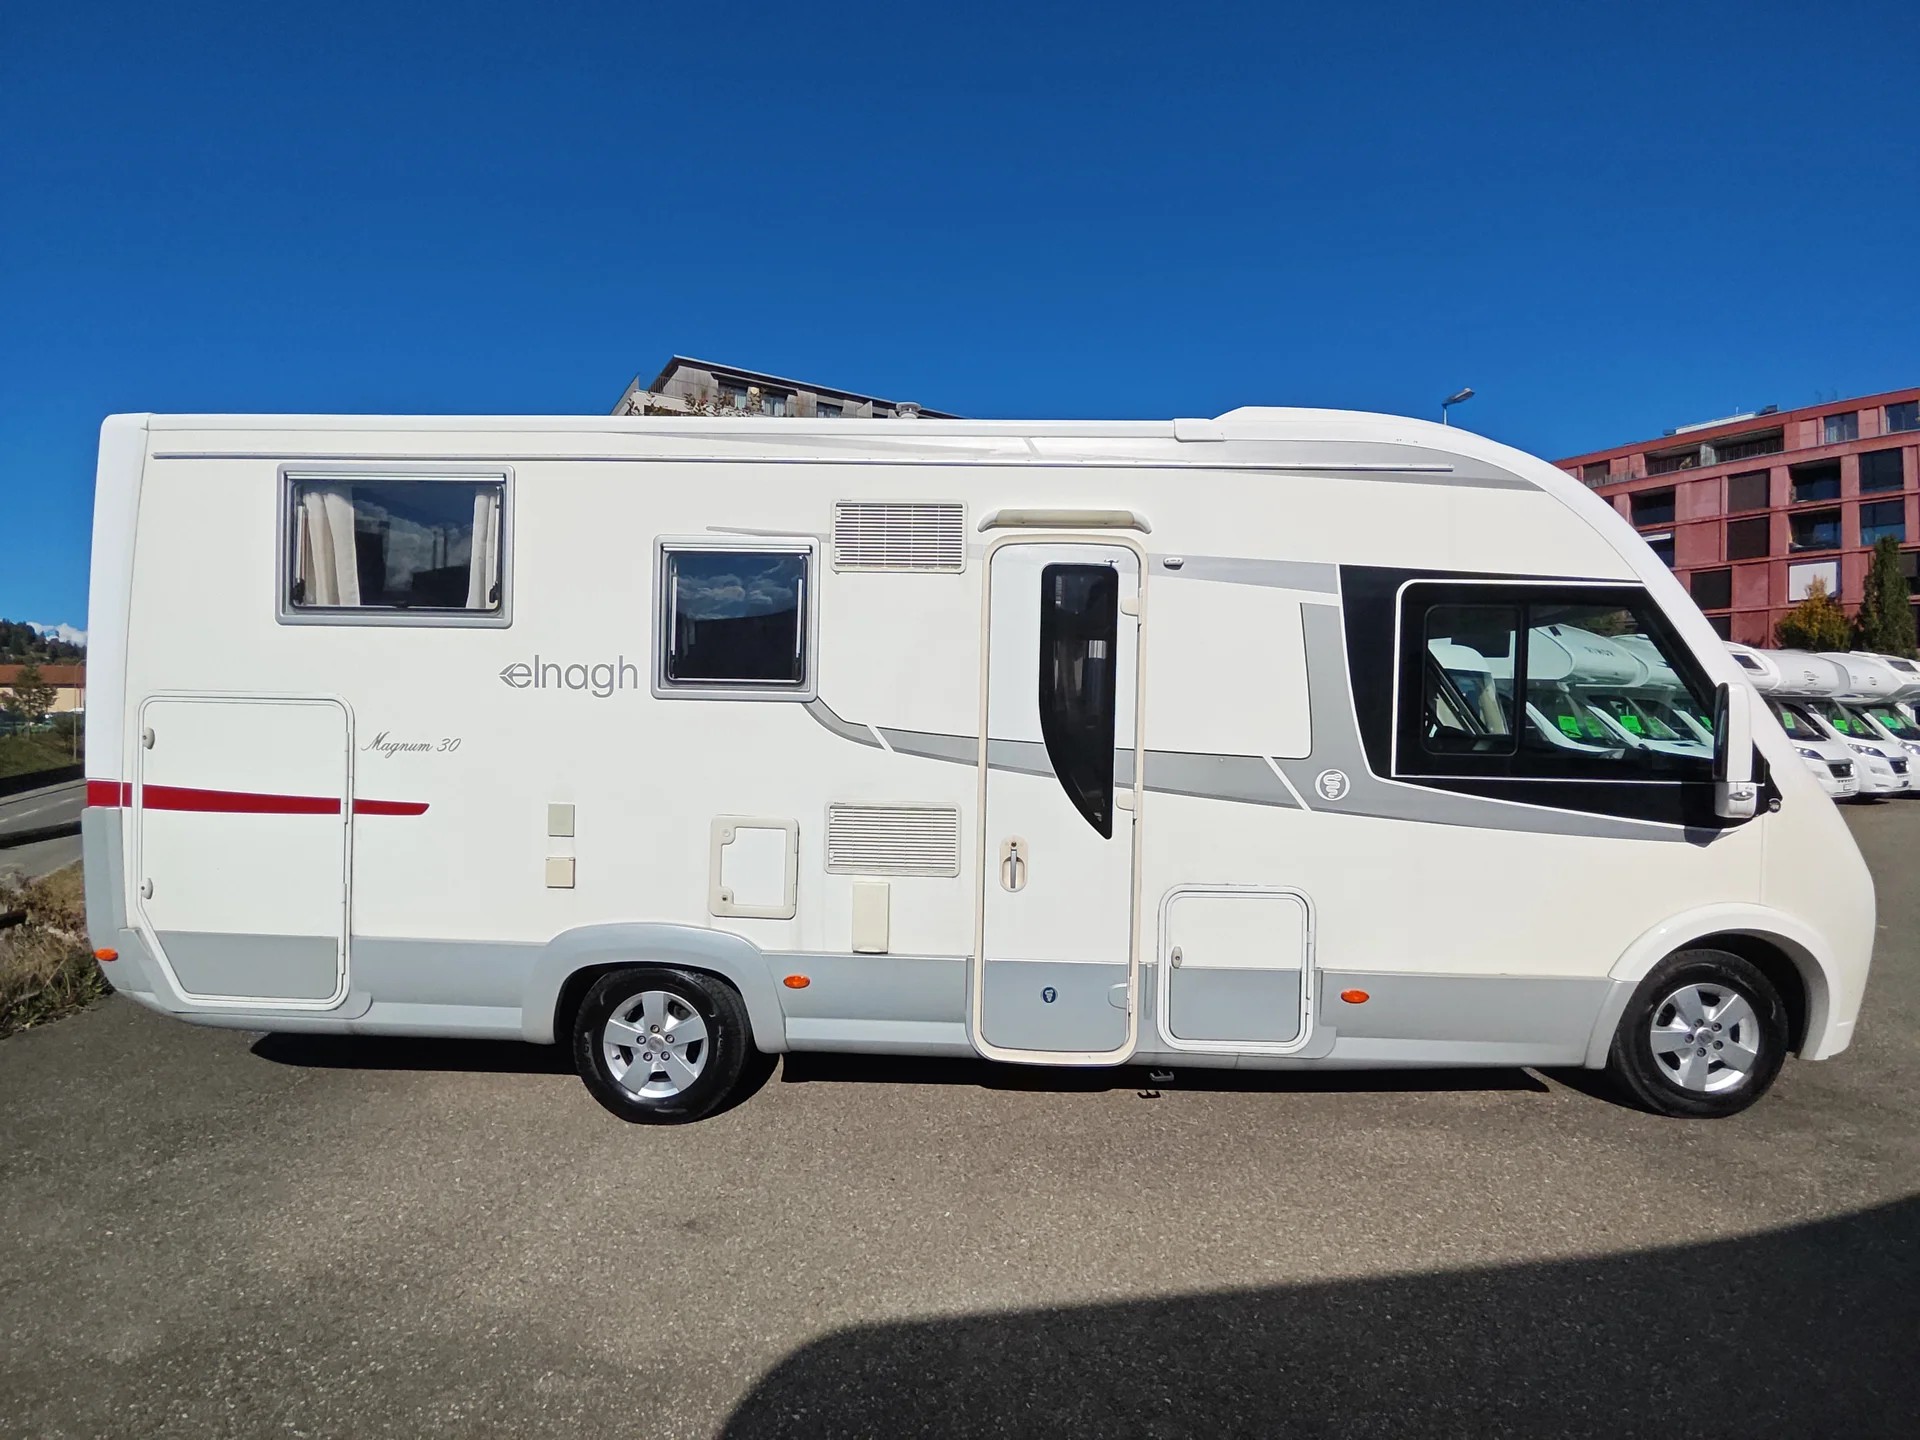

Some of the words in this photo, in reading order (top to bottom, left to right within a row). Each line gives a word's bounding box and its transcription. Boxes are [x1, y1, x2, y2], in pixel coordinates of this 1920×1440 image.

[508, 654, 638, 699] elnagh
[360, 730, 433, 759] Magnum
[436, 737, 462, 753] 30
